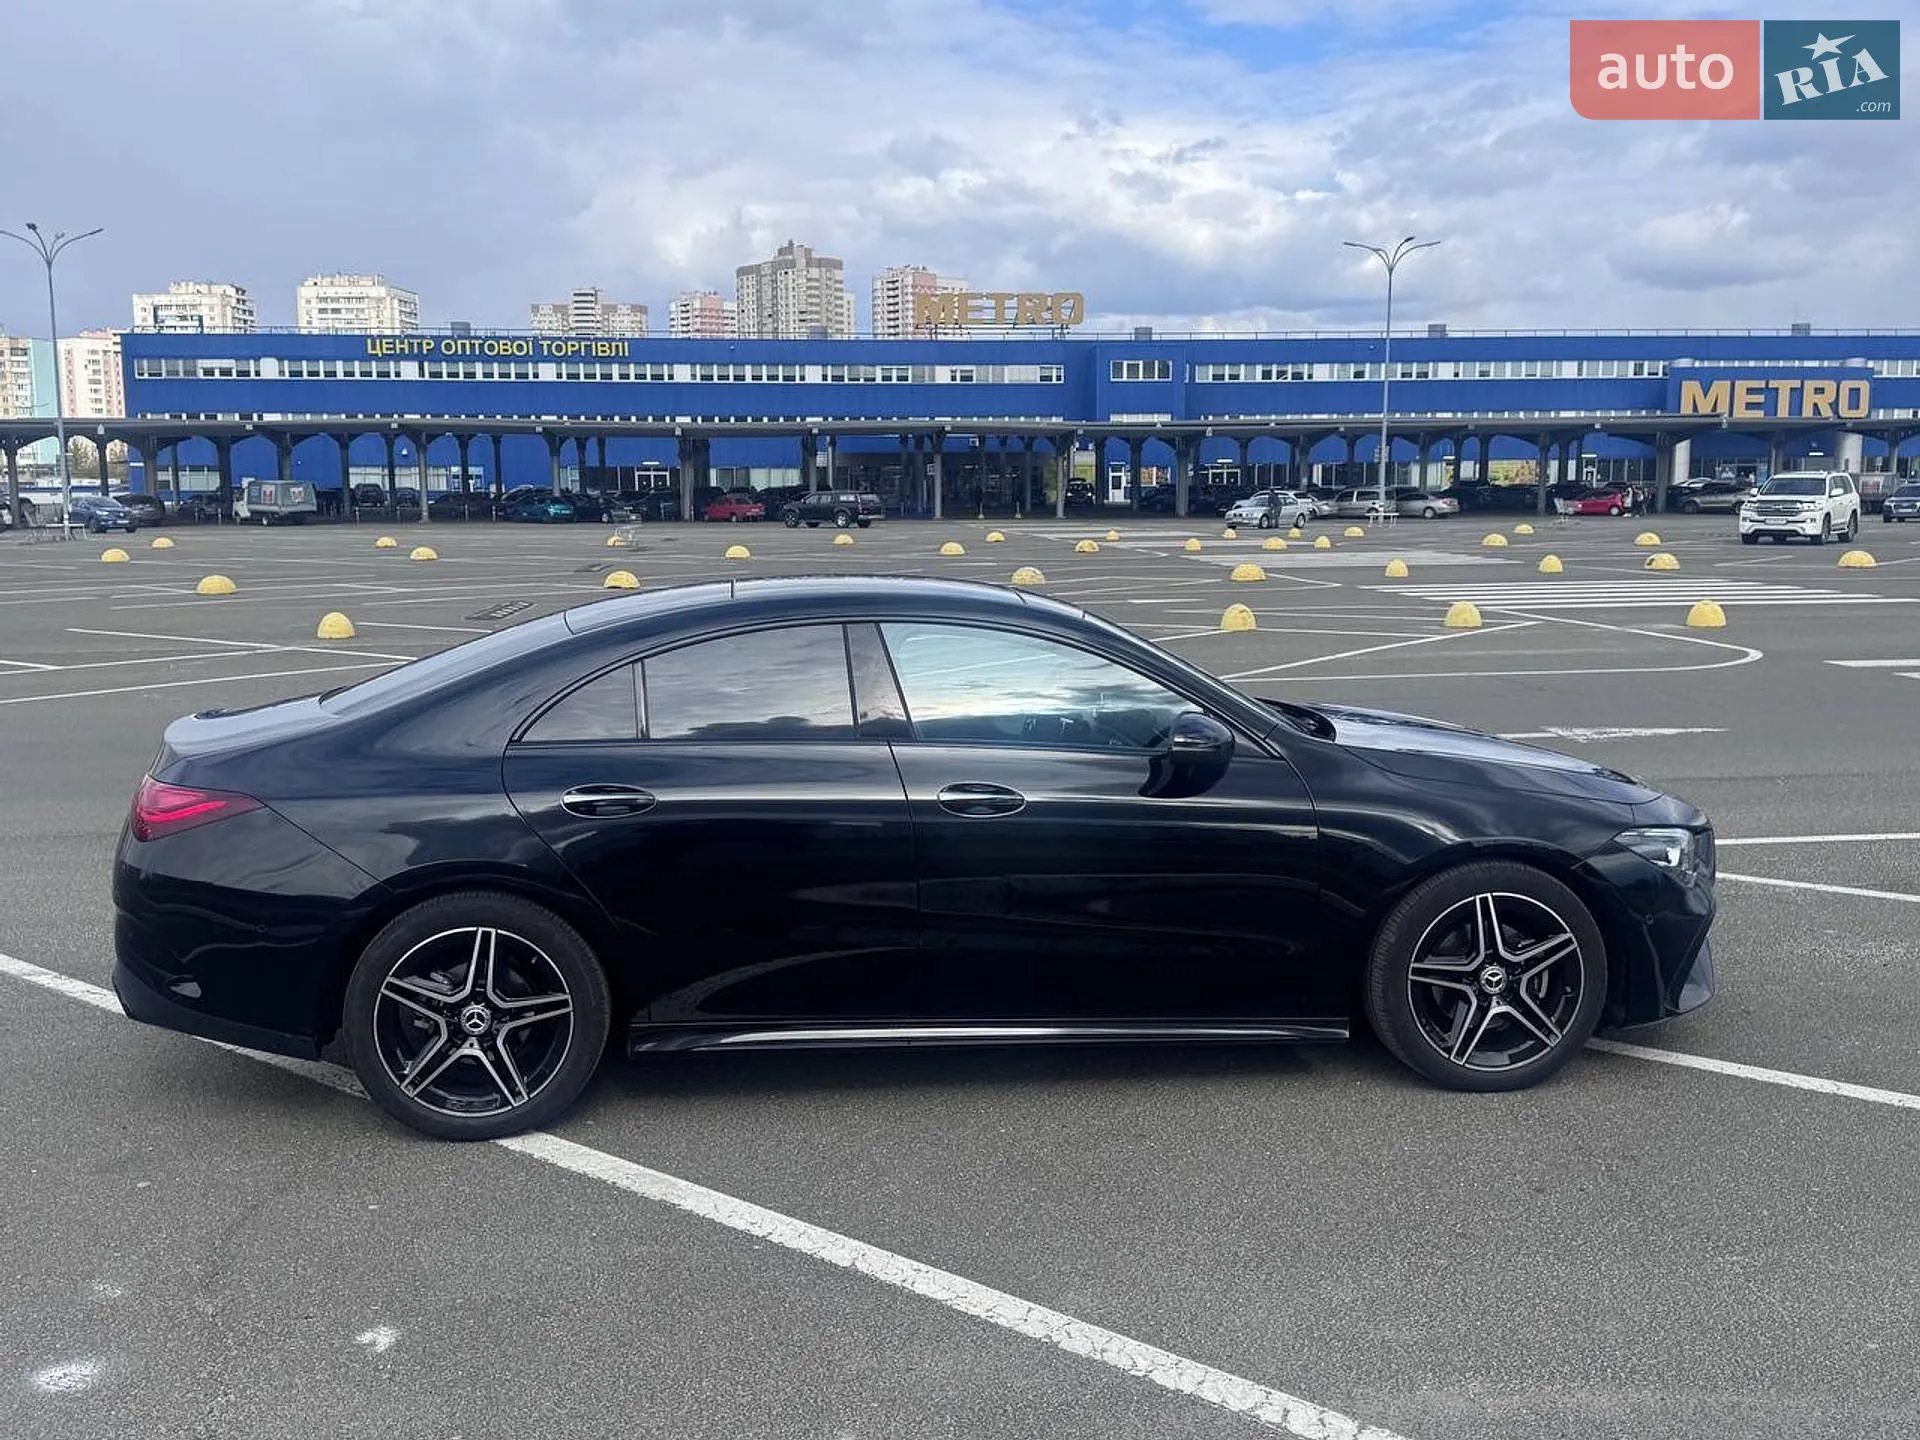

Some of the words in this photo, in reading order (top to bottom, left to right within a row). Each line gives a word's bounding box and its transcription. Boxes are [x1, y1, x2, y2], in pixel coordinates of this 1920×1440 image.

[916, 293, 1085, 325] METRO
[366, 338, 434, 357] ЦЕНТР
[441, 338, 533, 356] ОПТОВОЇ
[539, 340, 629, 358] ТОРГІВЛІ
[1680, 380, 1870, 419] METRO
